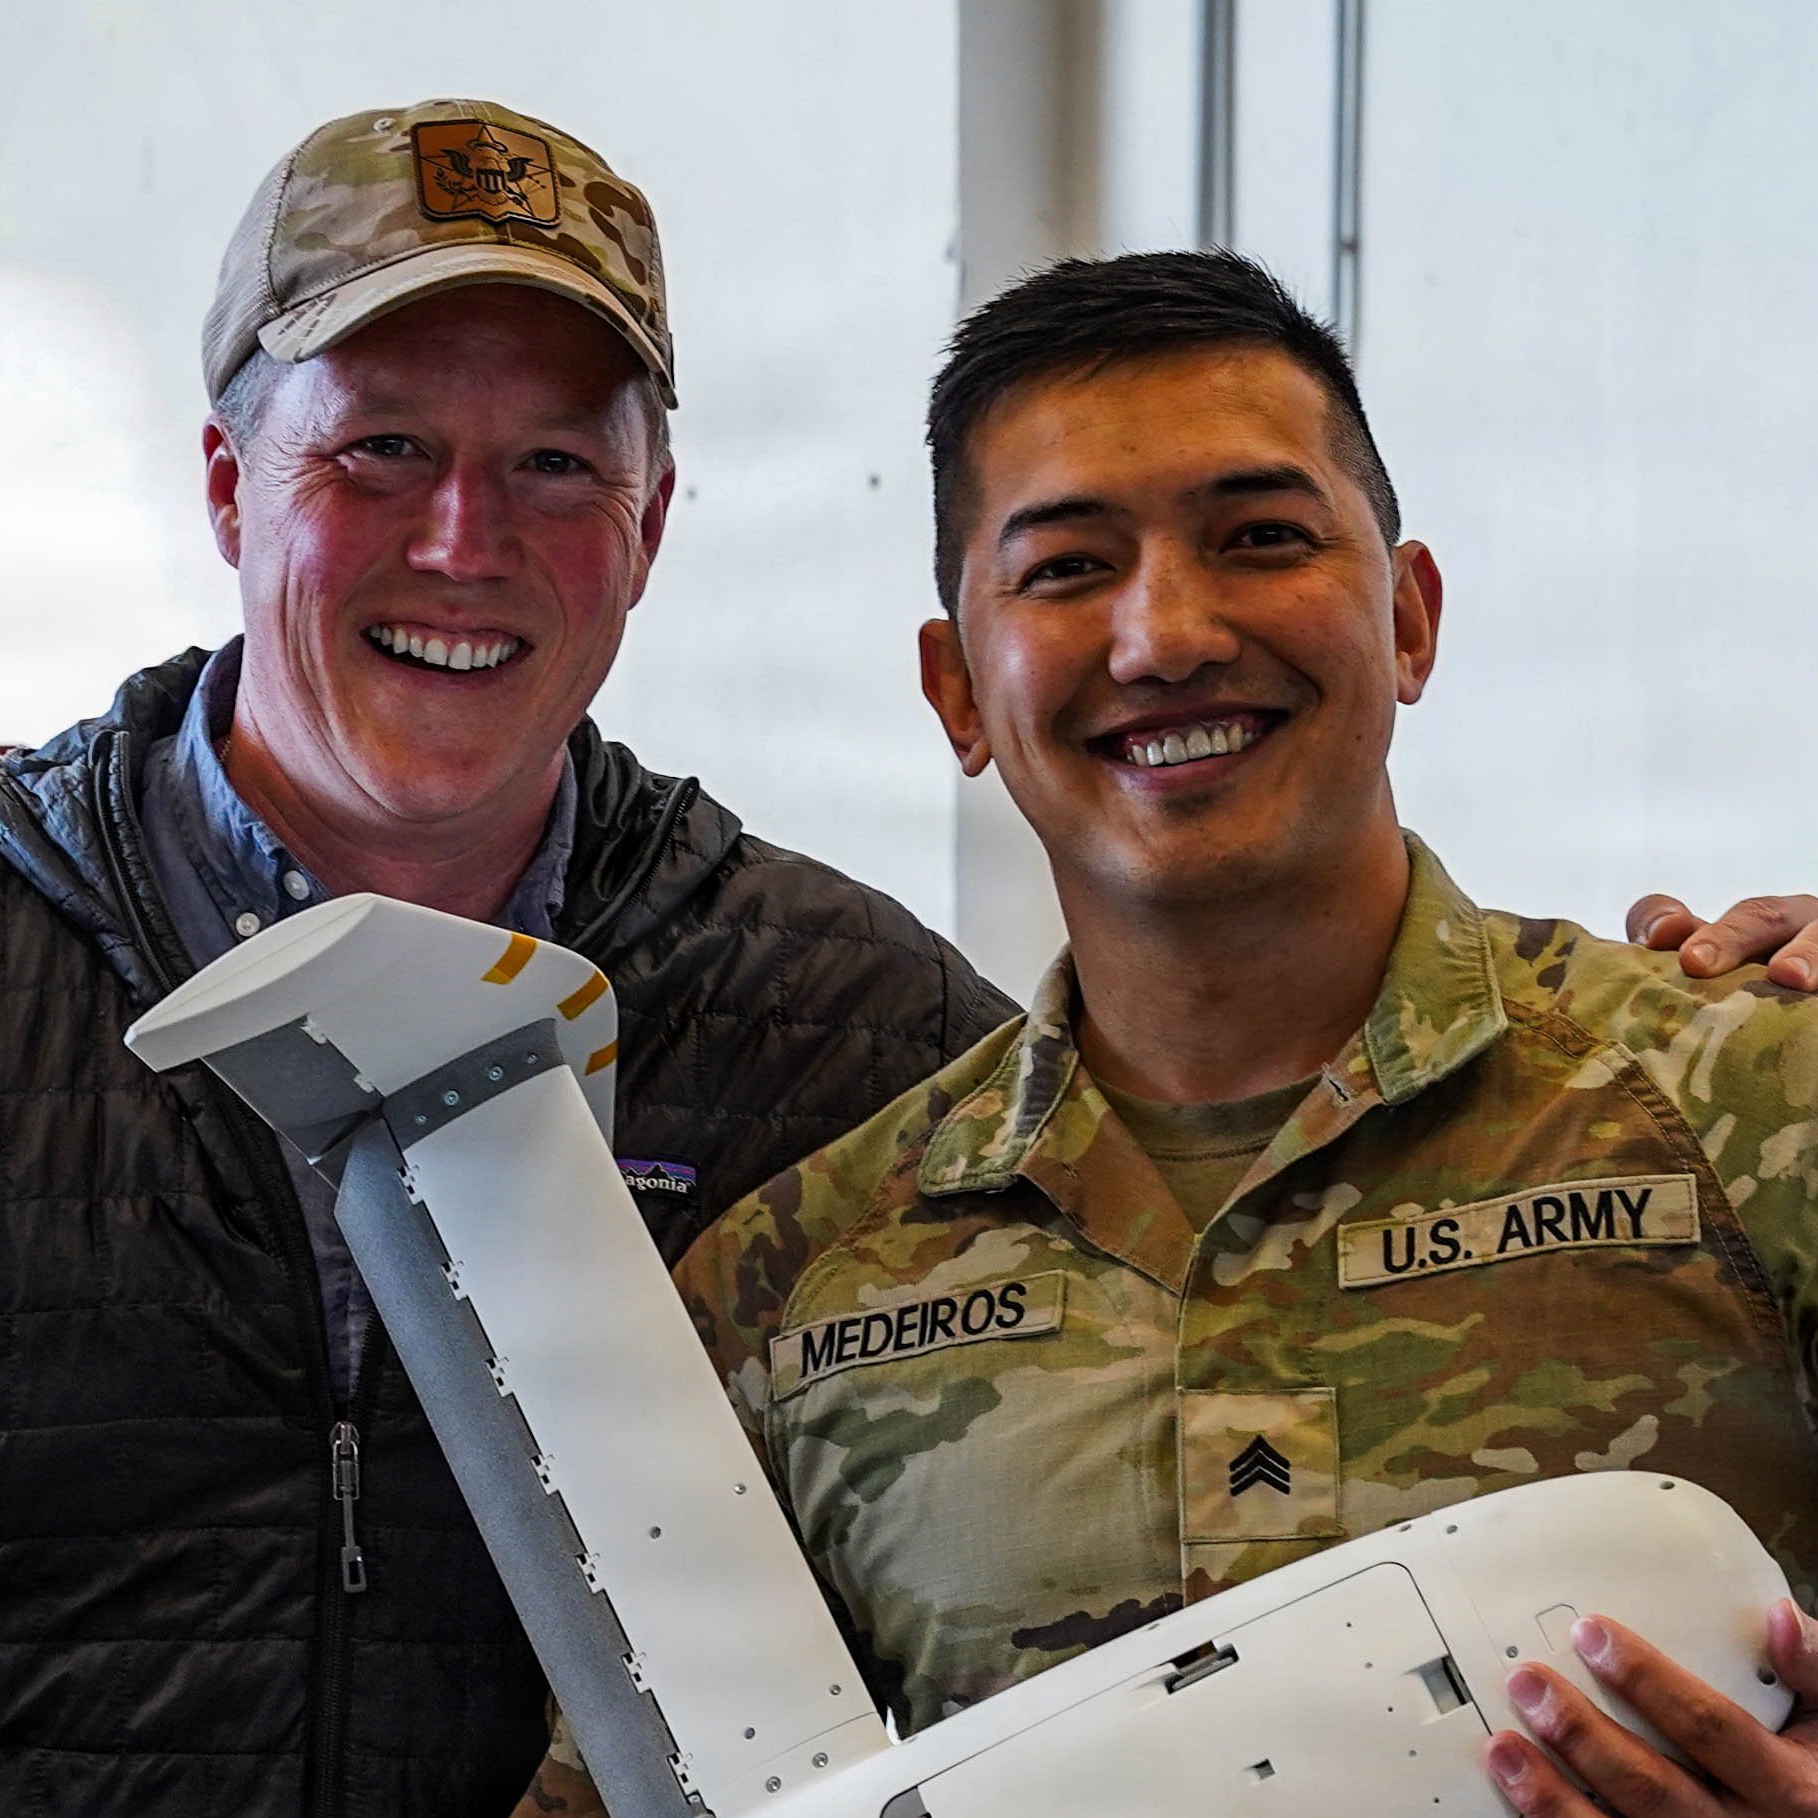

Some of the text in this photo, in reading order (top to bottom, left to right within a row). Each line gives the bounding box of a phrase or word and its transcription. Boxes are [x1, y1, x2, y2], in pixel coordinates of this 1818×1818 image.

[626, 1174, 689, 1194] agonia
[1382, 1188, 1653, 1274] U.S. ARMY
[799, 1281, 1027, 1378] MEDEIROS
